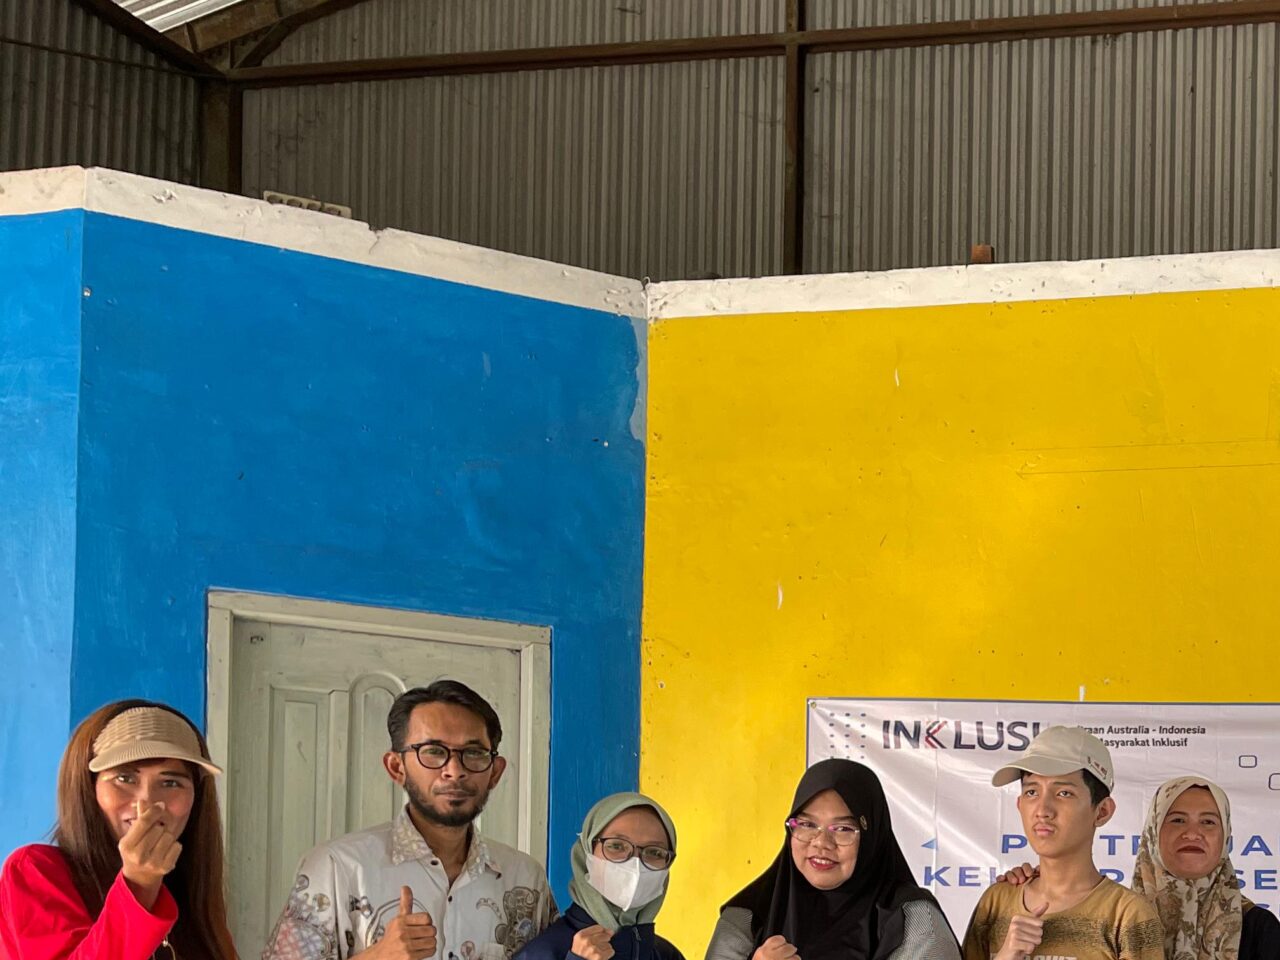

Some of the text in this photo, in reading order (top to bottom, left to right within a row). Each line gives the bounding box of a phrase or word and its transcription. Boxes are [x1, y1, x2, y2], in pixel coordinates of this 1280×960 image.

[1107, 725, 1150, 734] Australia
[1159, 725, 1206, 734] Indonesia
[1152, 738, 1188, 748] Inklusif
